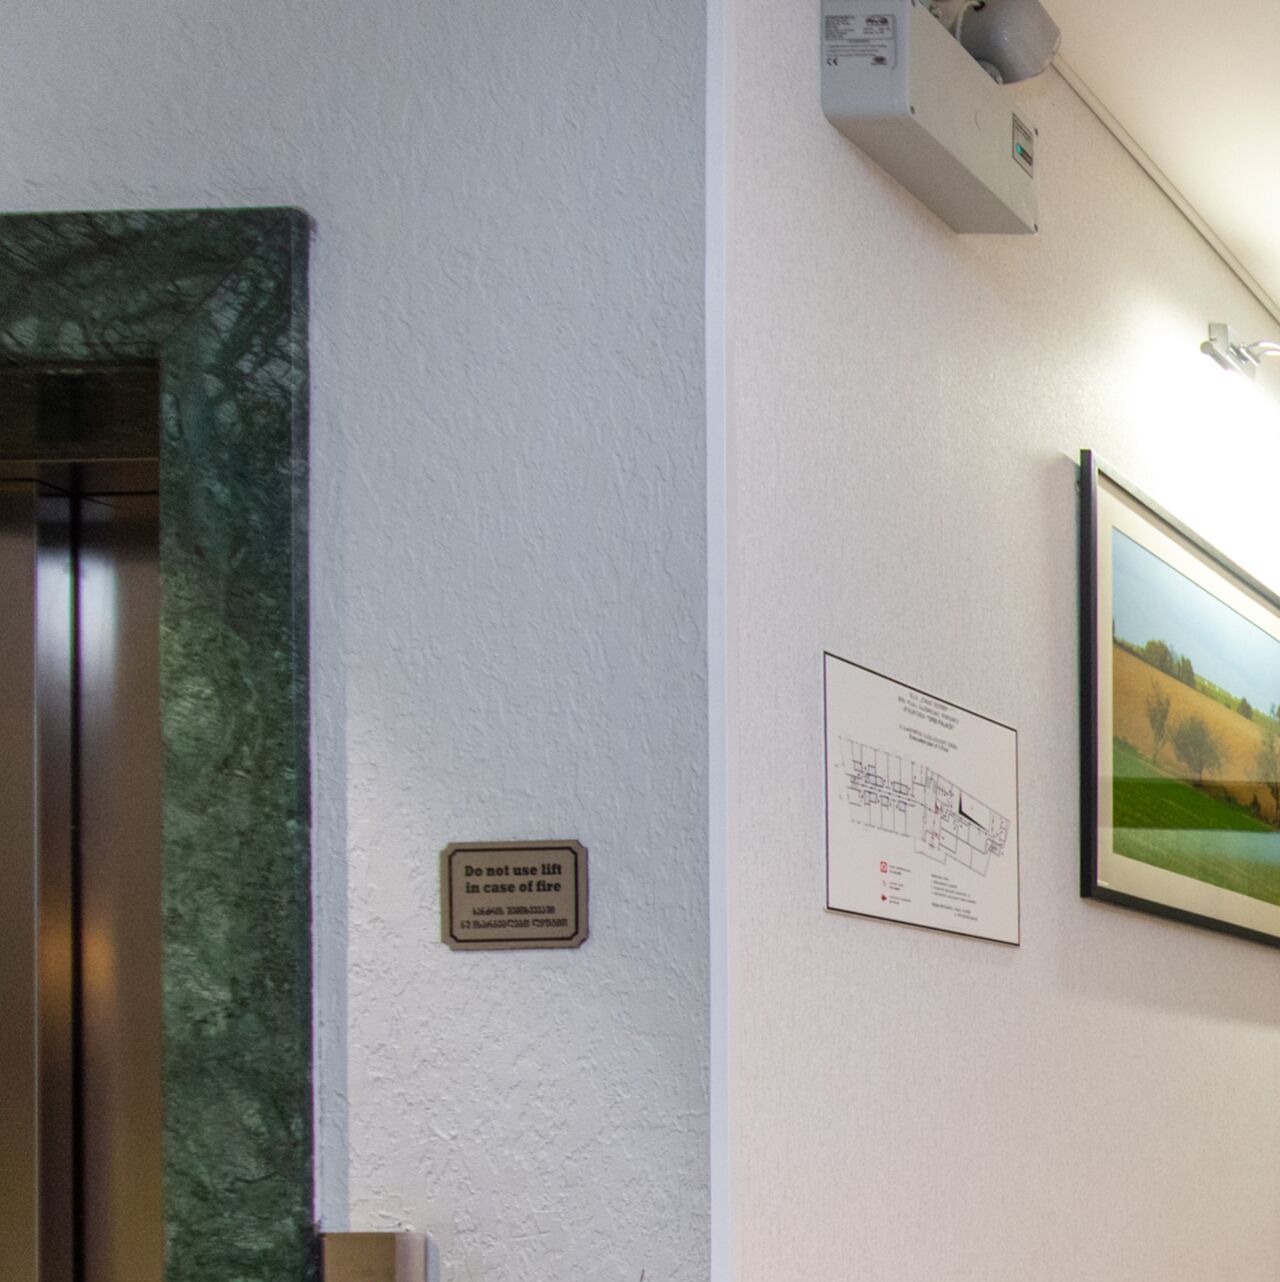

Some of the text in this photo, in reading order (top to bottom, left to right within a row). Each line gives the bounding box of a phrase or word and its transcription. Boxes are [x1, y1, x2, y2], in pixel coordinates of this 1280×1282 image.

[464, 863, 563, 877] Do not use lift
[465, 880, 562, 894] in case of fire
